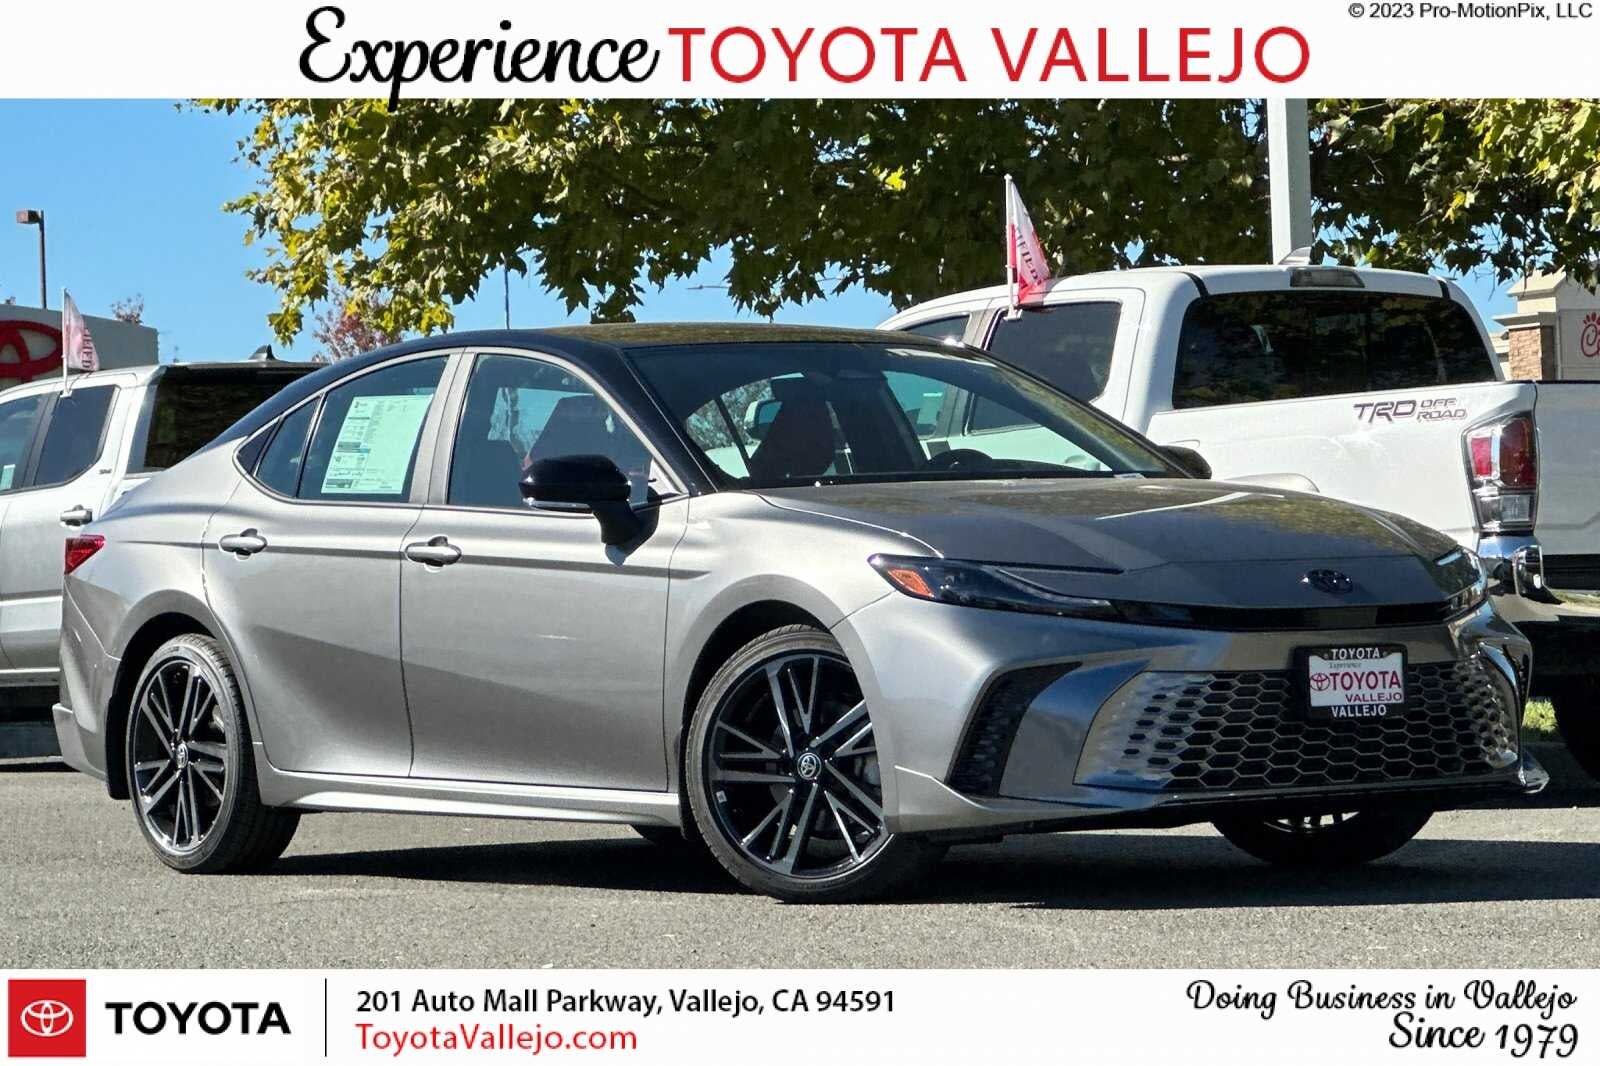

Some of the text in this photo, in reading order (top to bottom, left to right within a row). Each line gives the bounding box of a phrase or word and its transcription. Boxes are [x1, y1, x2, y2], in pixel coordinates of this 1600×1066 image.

[1353, 397, 1457, 423] TRD OFF
[1416, 408, 1467, 422] ROAD
[1331, 647, 1380, 660] TOYOTA
[1329, 670, 1402, 691] TOYOTA
[1345, 692, 1403, 703] VALLEJO
[1331, 704, 1387, 718] VALLEJO
